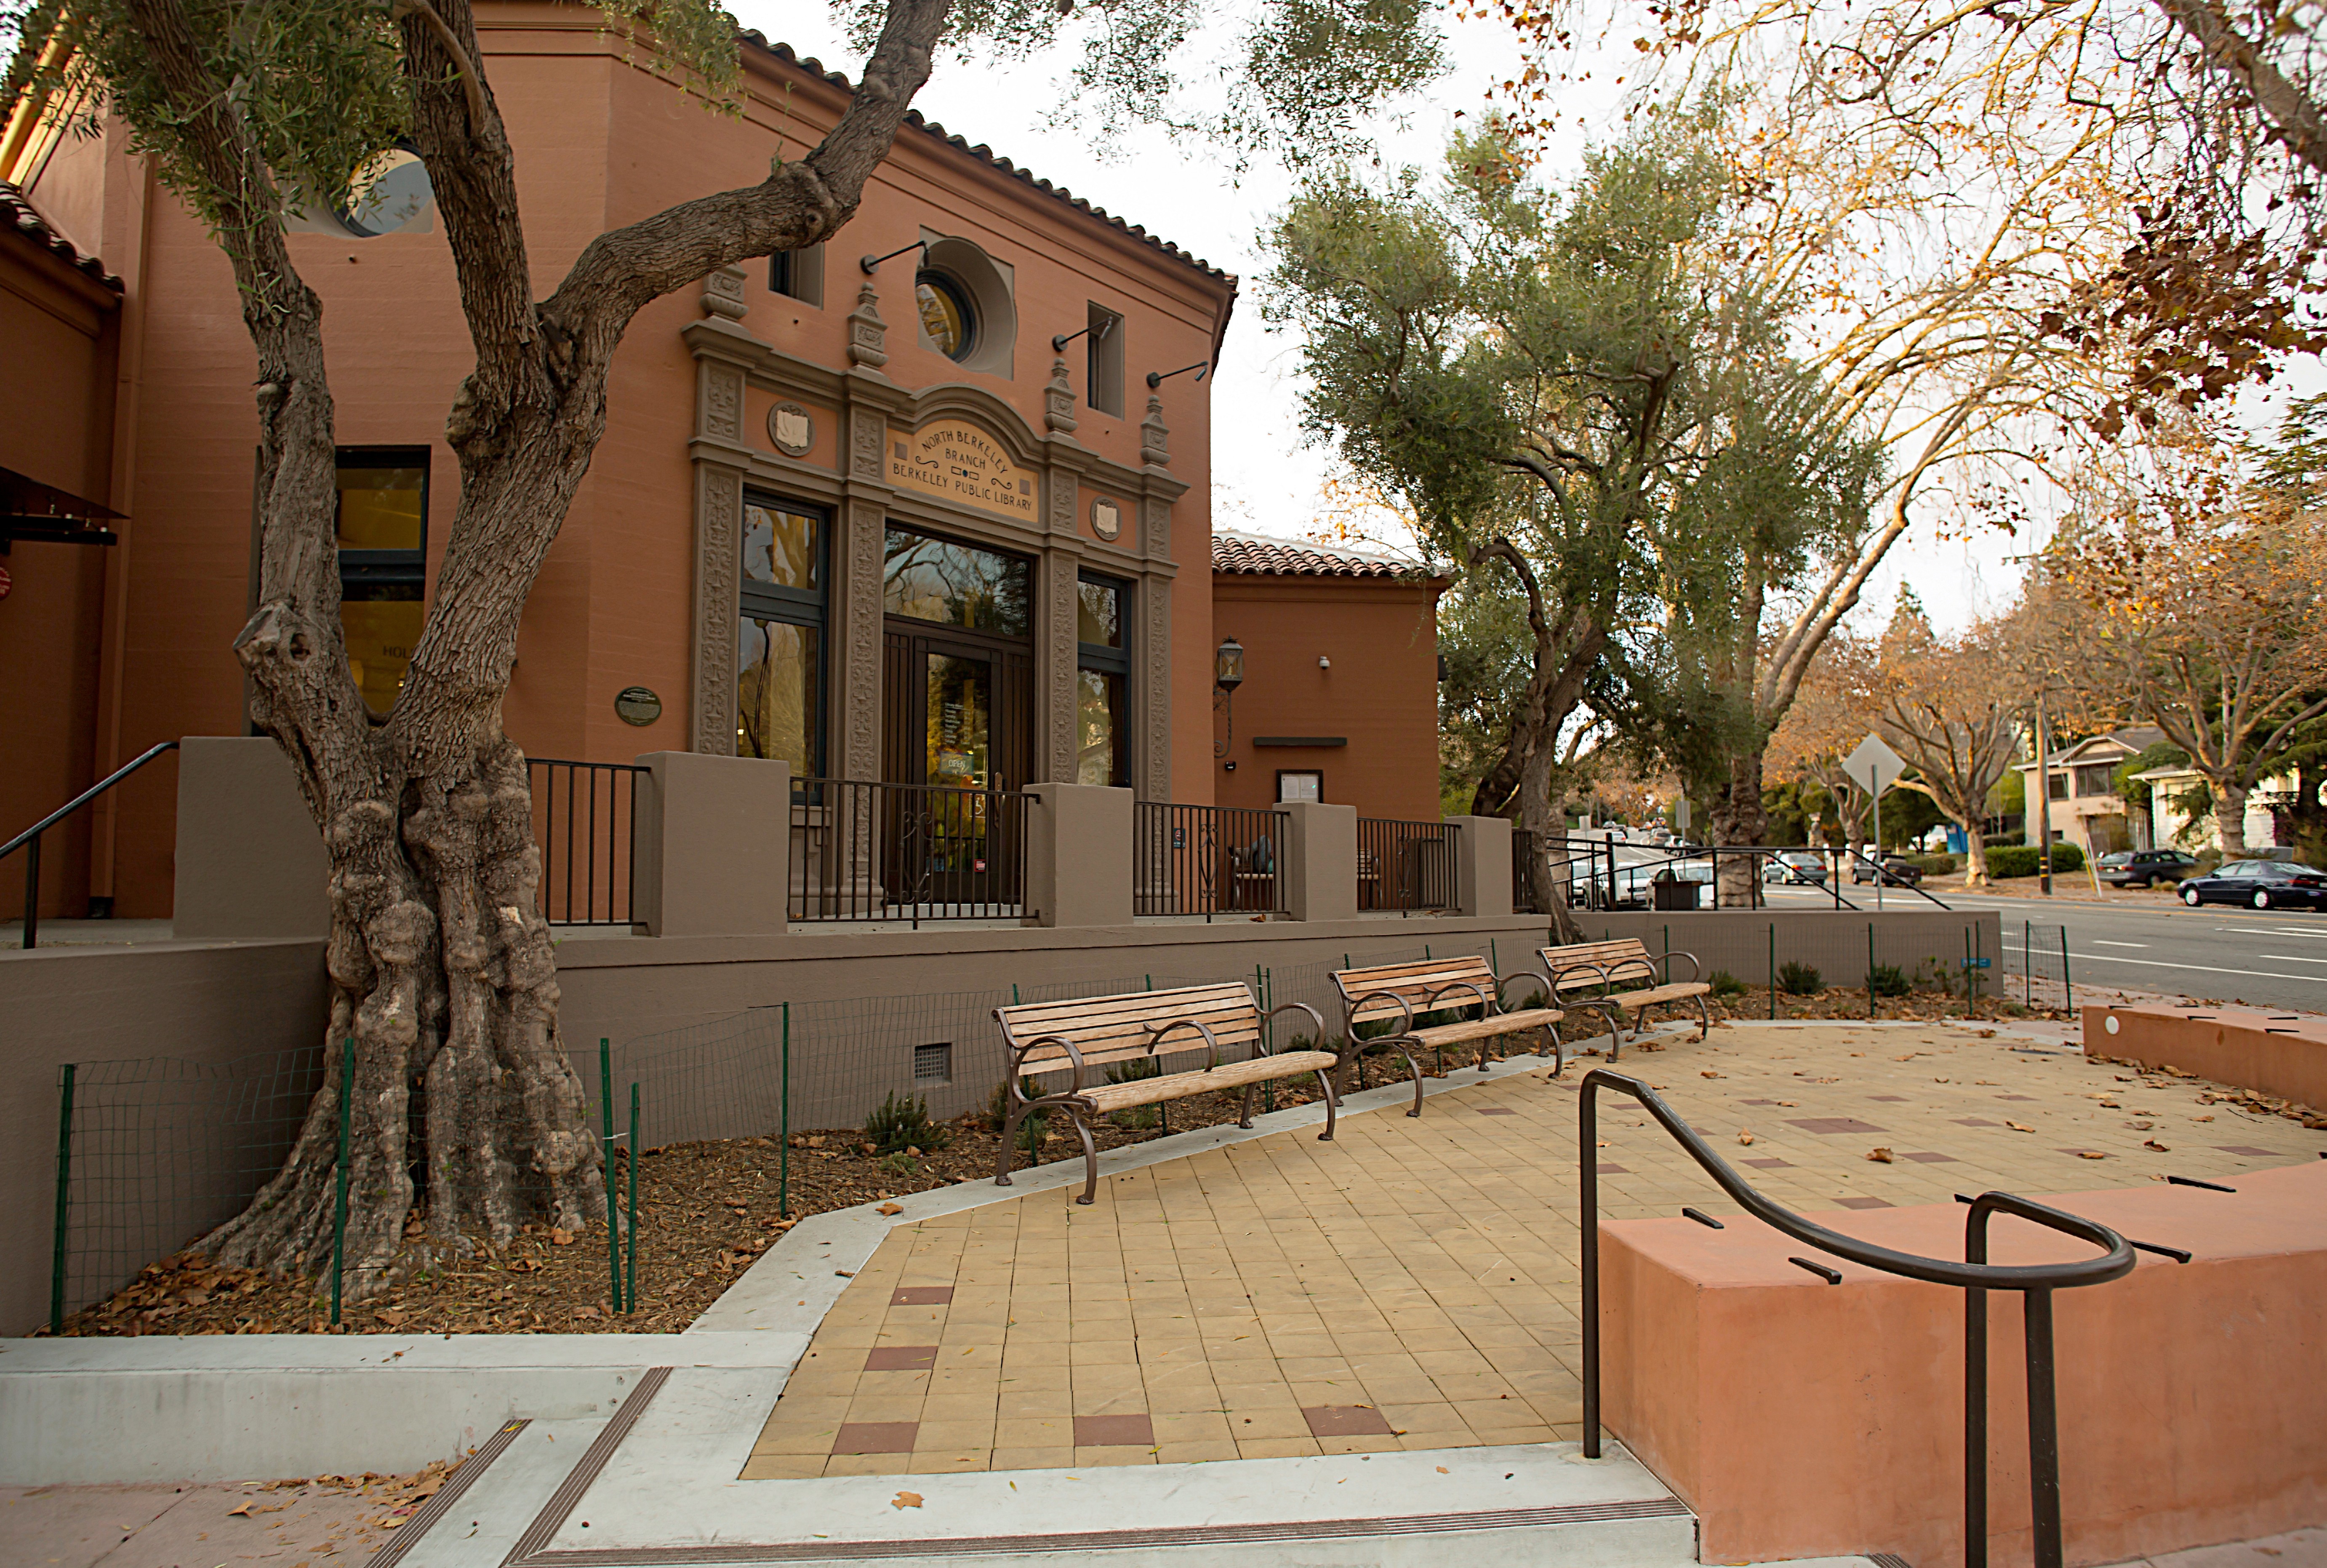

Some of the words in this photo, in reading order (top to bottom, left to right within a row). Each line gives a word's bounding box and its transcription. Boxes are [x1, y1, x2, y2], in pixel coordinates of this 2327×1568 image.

[922, 431, 954, 452] NORTH
[957, 431, 1008, 474] BERKELEY
[945, 448, 986, 470] BRANCH
[893, 464, 948, 488] BERKELEY
[955, 480, 991, 500] PUBLIC
[994, 491, 1032, 511] LIBRARY
[948, 759, 966, 768] OPEN
